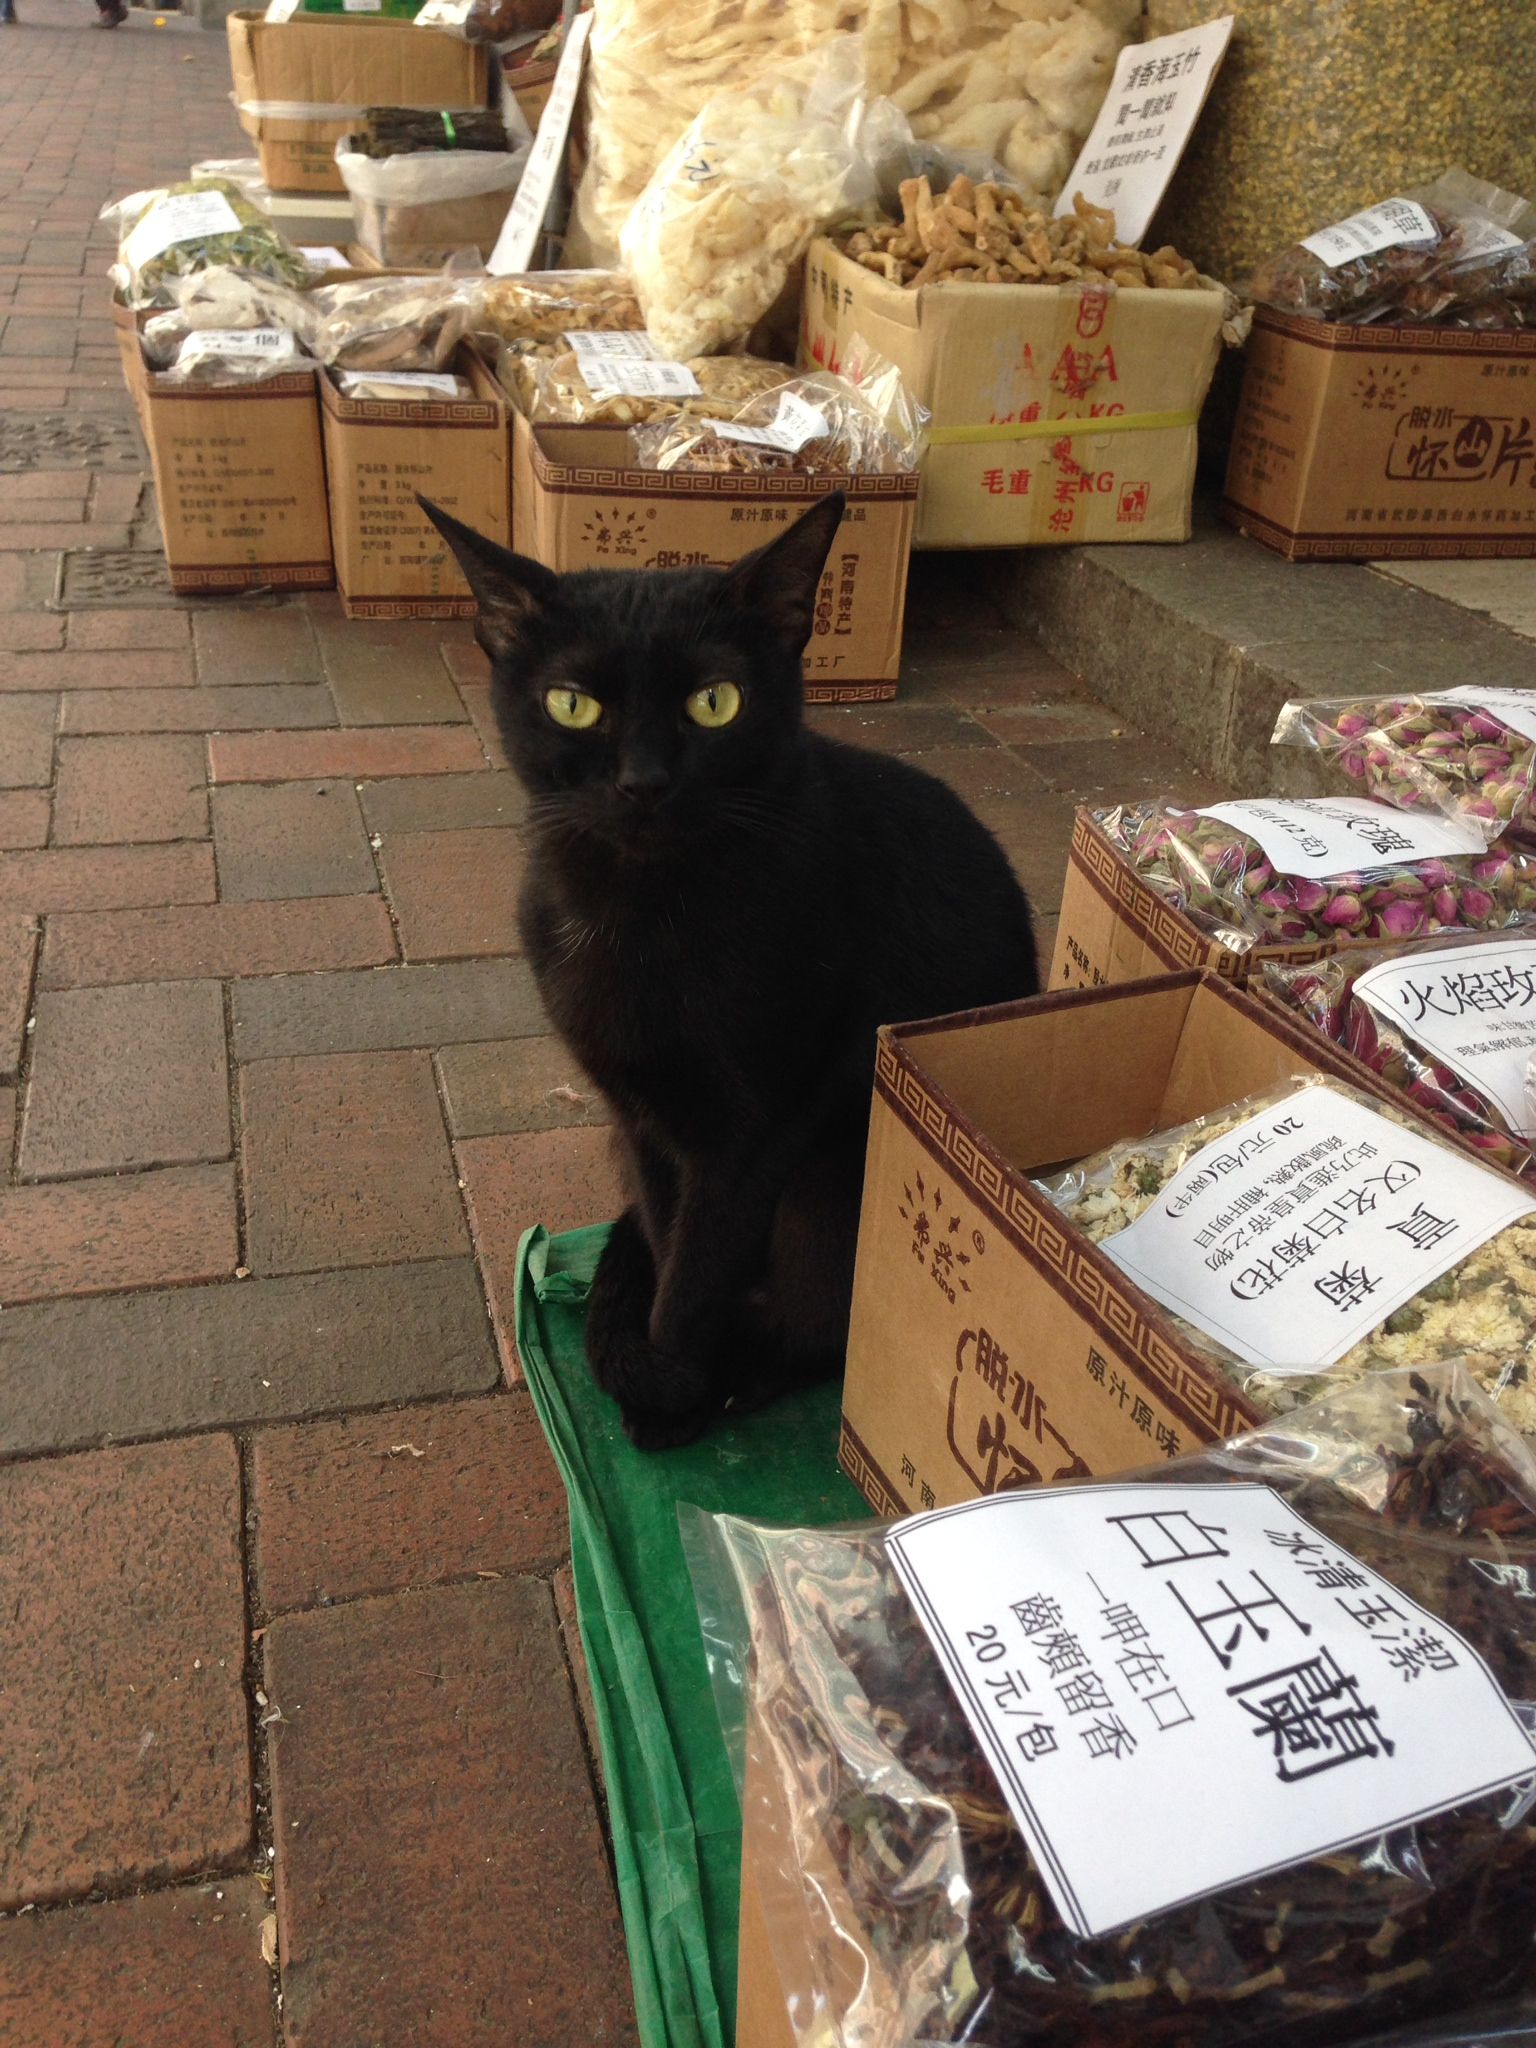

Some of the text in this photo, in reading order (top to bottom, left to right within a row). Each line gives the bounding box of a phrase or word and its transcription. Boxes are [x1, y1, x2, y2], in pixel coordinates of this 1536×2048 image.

[729, 507, 790, 523] 原汁原味
[981, 468, 1115, 496] 毛重 KG
[1399, 964, 1536, 1022] 火焰玫
[1271, 1115, 1305, 1137] 20
[1203, 1141, 1380, 1272] 此乃進貢皇帝之物
[1229, 1159, 1422, 1301] (又名白菊花)
[1313, 1201, 1461, 1313] 貢 菊
[975, 1327, 1049, 1446] 脱水
[1084, 1344, 1182, 1459] 原汁原味
[1105, 1509, 1397, 1784] 白玉蘭
[1263, 1528, 1460, 1684] 冰清玉潔
[965, 1623, 1060, 1764] 20 元/包
[1008, 1590, 1139, 1761] 齒頰留香
